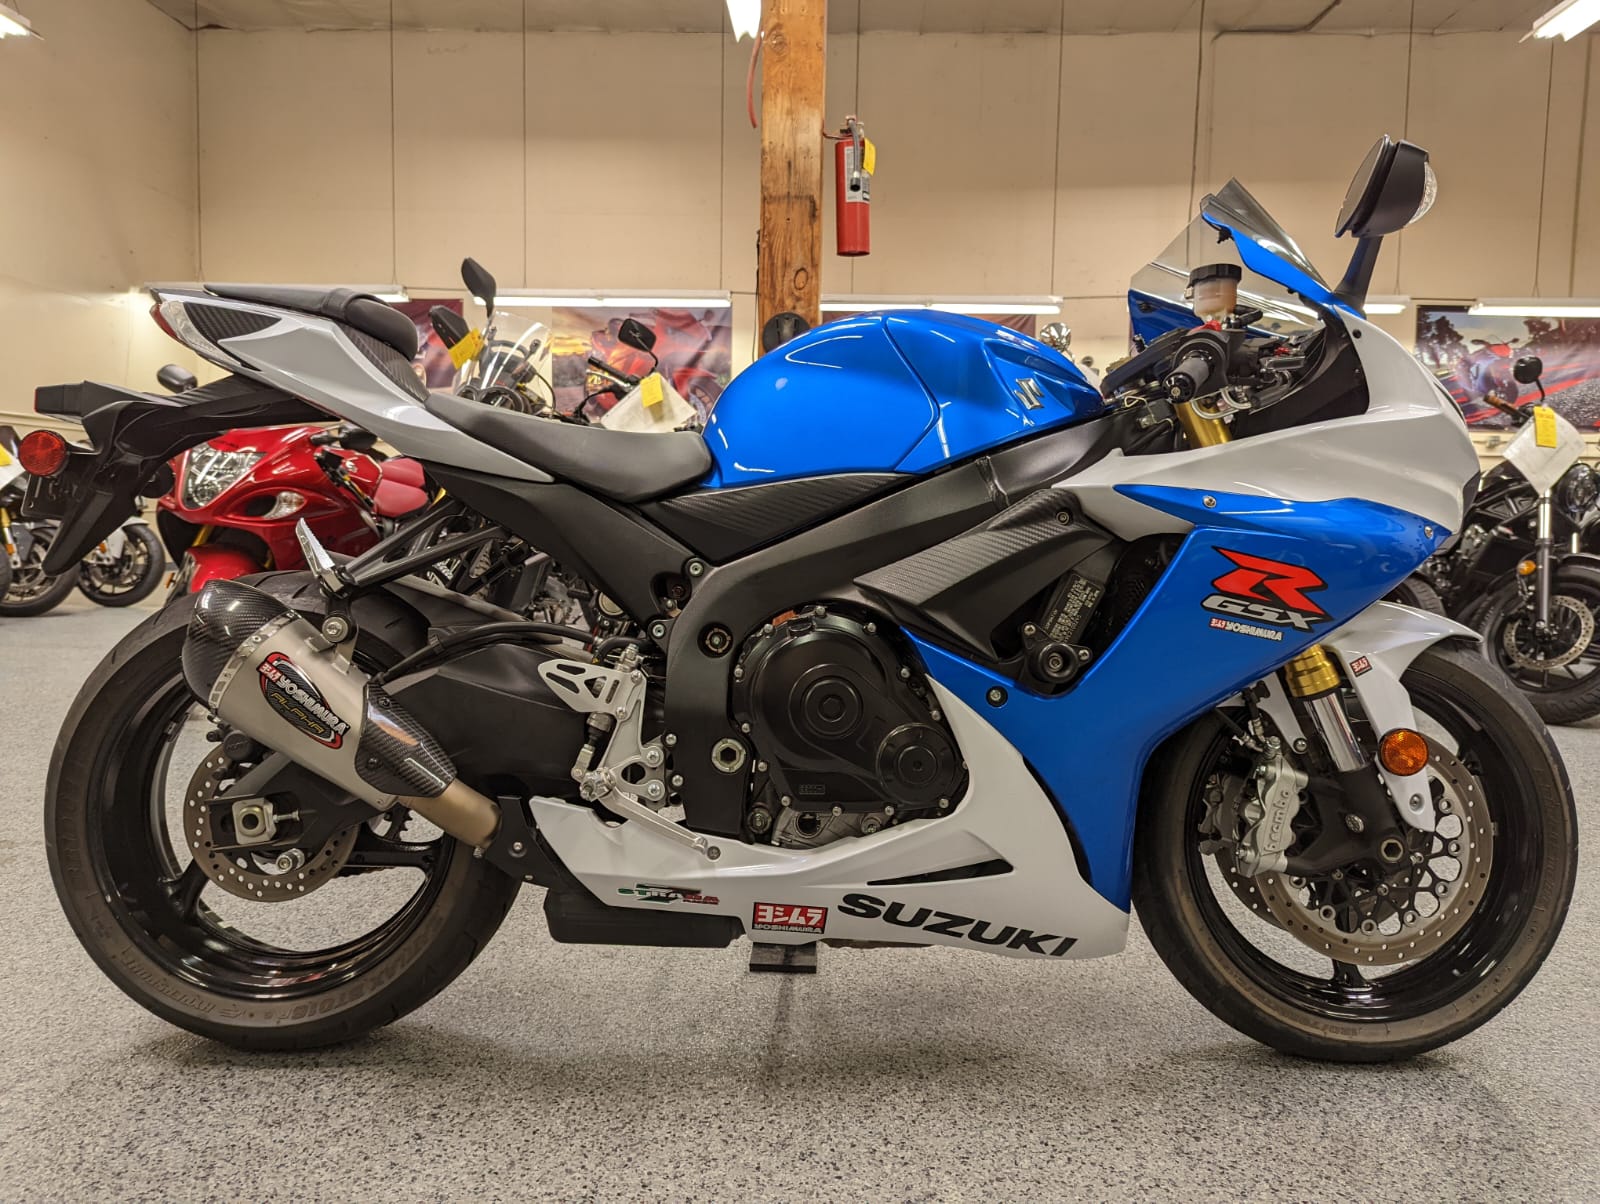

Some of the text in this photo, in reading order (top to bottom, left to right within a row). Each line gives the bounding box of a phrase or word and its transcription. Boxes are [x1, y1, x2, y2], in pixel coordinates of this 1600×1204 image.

[1201, 594, 1324, 630] GSX
[1225, 621, 1282, 641] YOSHIMURA
[271, 692, 325, 734] ALPHA
[276, 675, 348, 735] YOSHIMURA
[754, 923, 822, 933] YOSHIMURA
[756, 905, 823, 926] ヨシムラ
[837, 893, 1079, 957] SUZUKI
